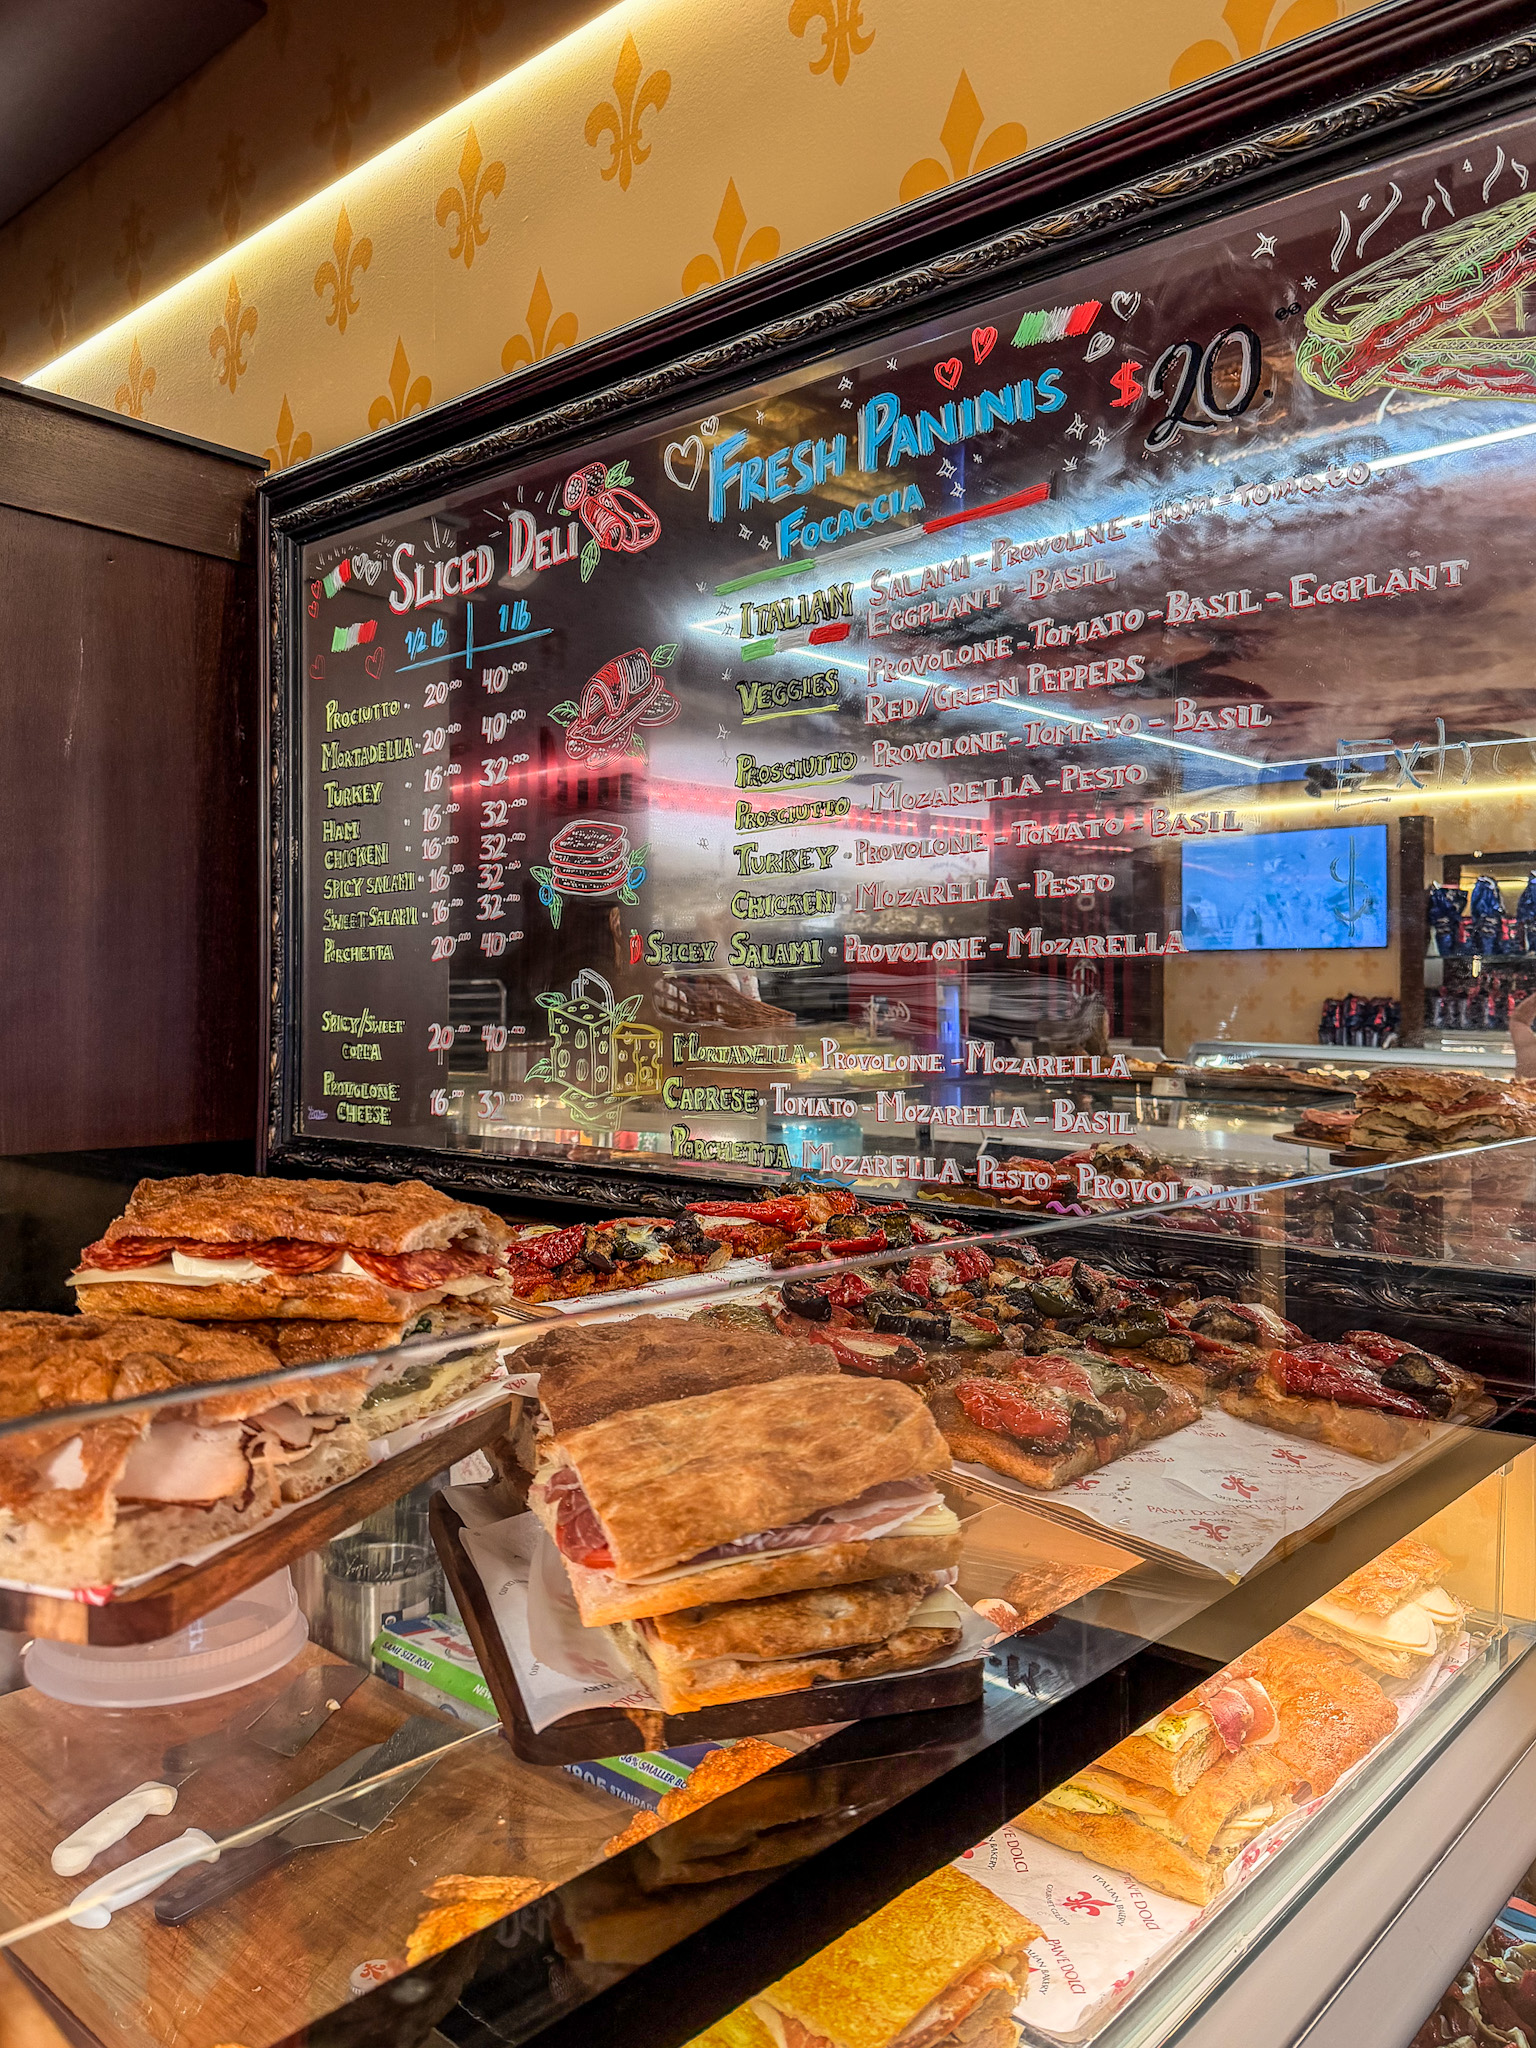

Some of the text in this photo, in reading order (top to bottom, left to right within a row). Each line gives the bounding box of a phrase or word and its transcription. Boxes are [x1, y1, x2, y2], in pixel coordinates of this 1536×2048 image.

[708, 367, 1068, 524] FRESH PANINIS
[776, 482, 926, 561] FOCACCIA
[389, 510, 579, 615] SLICED DELI
[739, 581, 855, 639] ITALIAN
[868, 553, 971, 606] SALAMI
[866, 558, 1117, 640] EGGPLANT BASIL
[736, 559, 1470, 715] VEGGIES PROVOLONE TOMATO BASIL EGGPLANT
[864, 654, 1146, 727] RED/GREEN PEPPERS
[325, 699, 400, 733] PROCIUTTO
[321, 737, 415, 773] MORTADELLA
[734, 696, 1273, 789] PROSCIUTTO PROVOLONE TOMATO BASIL
[323, 780, 384, 809] TURKEY
[734, 763, 1148, 831] PROSCIUTTO MOZARELLA PESTO
[322, 819, 361, 843] HAM
[733, 807, 1244, 877] TURKEY PROVOLONE TOMATO BASIL
[324, 843, 390, 870] CHICKEN
[323, 877, 365, 900] SPICY
[366, 872, 416, 894] SALAMI
[730, 869, 1115, 920] CHICKEN MOZARELLA PESTO
[322, 908, 368, 931] SWEET
[368, 906, 419, 927] SALAMI
[323, 937, 395, 964] PORCHETTA
[644, 926, 1189, 970] SPICEY SALAMI PROVOLONE MOZARELLA
[321, 1007, 406, 1038] SPICY/SWEET
[672, 1030, 1132, 1079] MORTADELLA PROVOLONE MOZARELLA
[336, 1101, 392, 1126] CHEESE
[662, 1076, 1137, 1136] CAPRESE TOMATO MOZARELLA BASIL
[670, 1123, 792, 1170] PORCHETTA
[802, 1139, 964, 1185] MOZARELLA
[976, 1154, 1051, 1191] PESTO
[400, 1648, 416, 1662] SIZE
[415, 1657, 434, 1671] ROLL
[638, 1761, 676, 1784] SMALLER
[1007, 1840, 1029, 1873] DOLCI
[1092, 1874, 1121, 1903] ITALIAN
[1134, 1900, 1161, 1931] DOLCI
[1060, 1963, 1087, 1995] DOLCI
